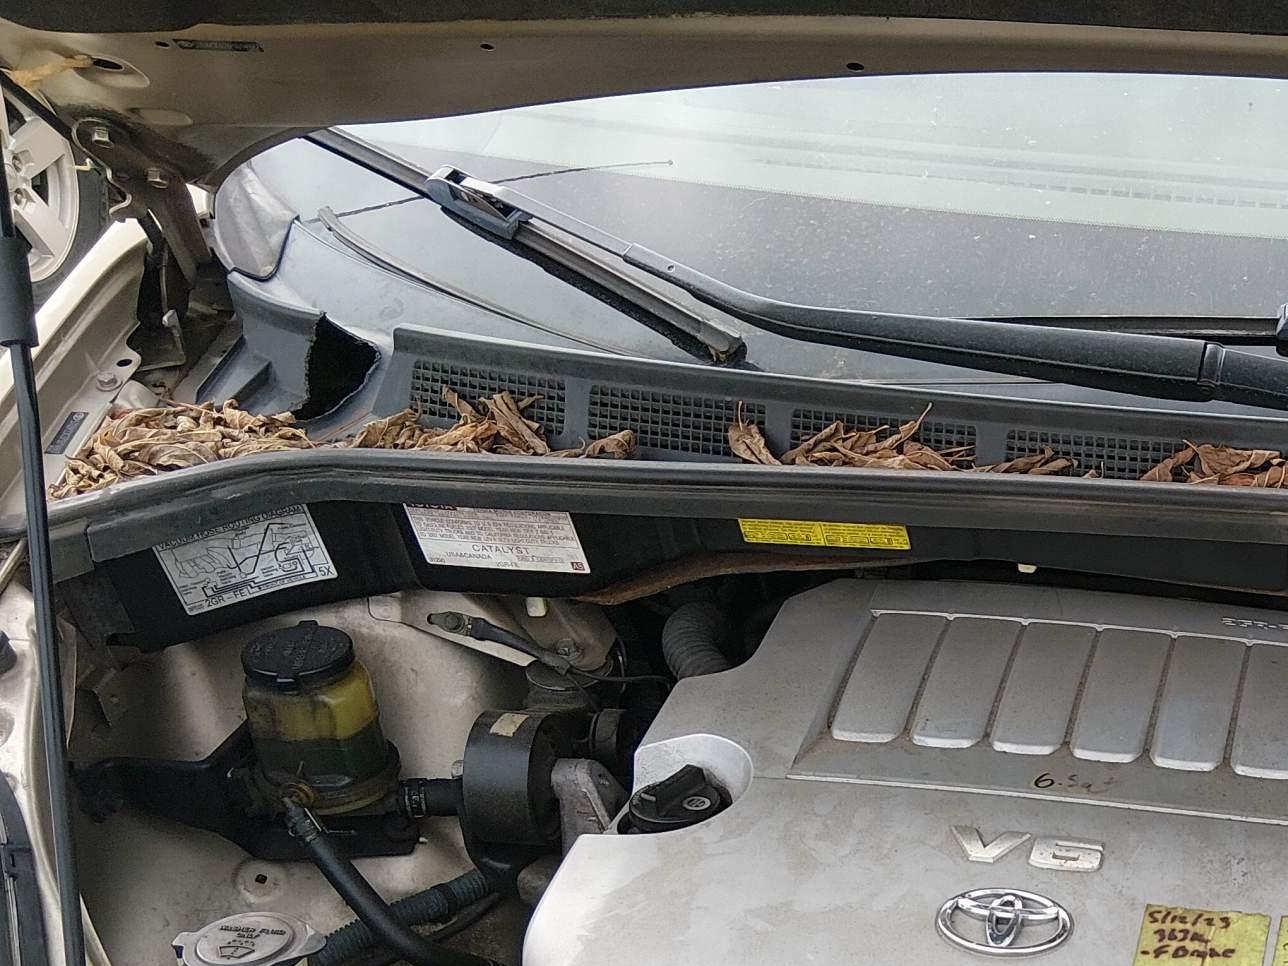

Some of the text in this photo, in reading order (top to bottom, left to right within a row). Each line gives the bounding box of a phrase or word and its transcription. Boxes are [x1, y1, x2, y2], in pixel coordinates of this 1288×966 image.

[471, 543, 530, 555] CATALYST
[318, 566, 336, 578] 5X
[951, 824, 1106, 874] V6
